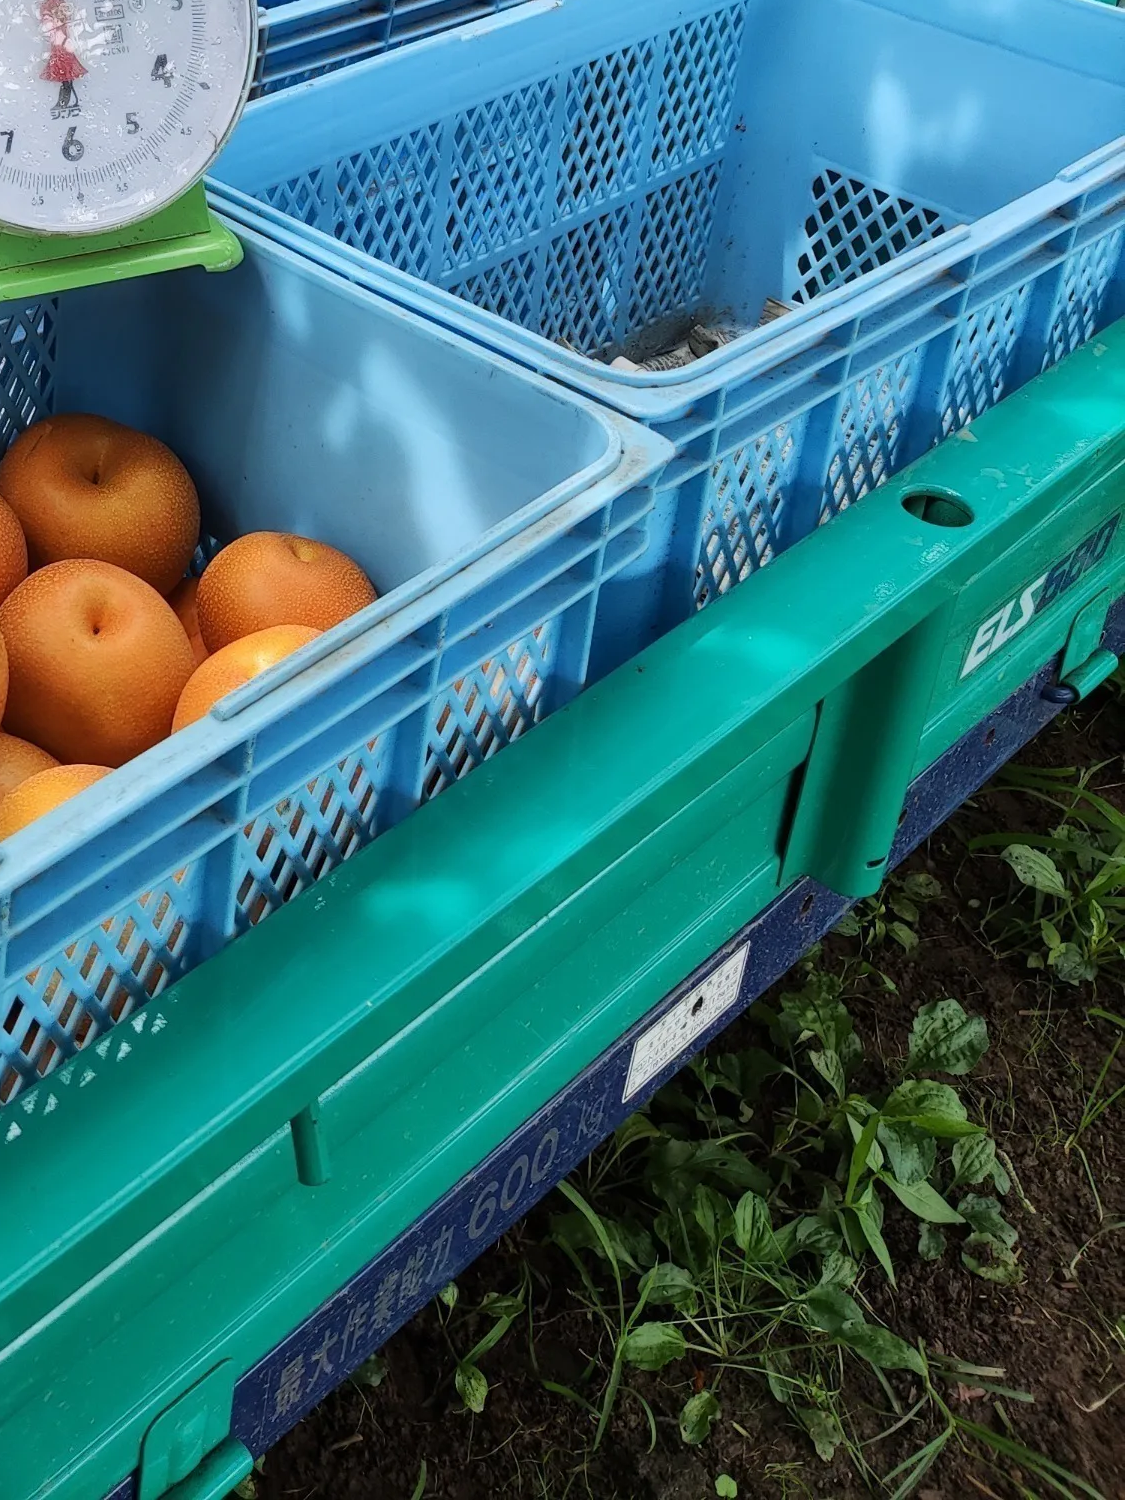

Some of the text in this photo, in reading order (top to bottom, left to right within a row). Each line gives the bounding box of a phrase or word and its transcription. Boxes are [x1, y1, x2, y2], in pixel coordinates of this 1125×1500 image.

[151, 54, 174, 88] 4
[125, 112, 140, 135] 5
[0, 129, 15, 154] 7
[61, 126, 85, 162] 6
[273, 1224, 458, 1417] 最大作業能力
[468, 1127, 560, 1241] 600
